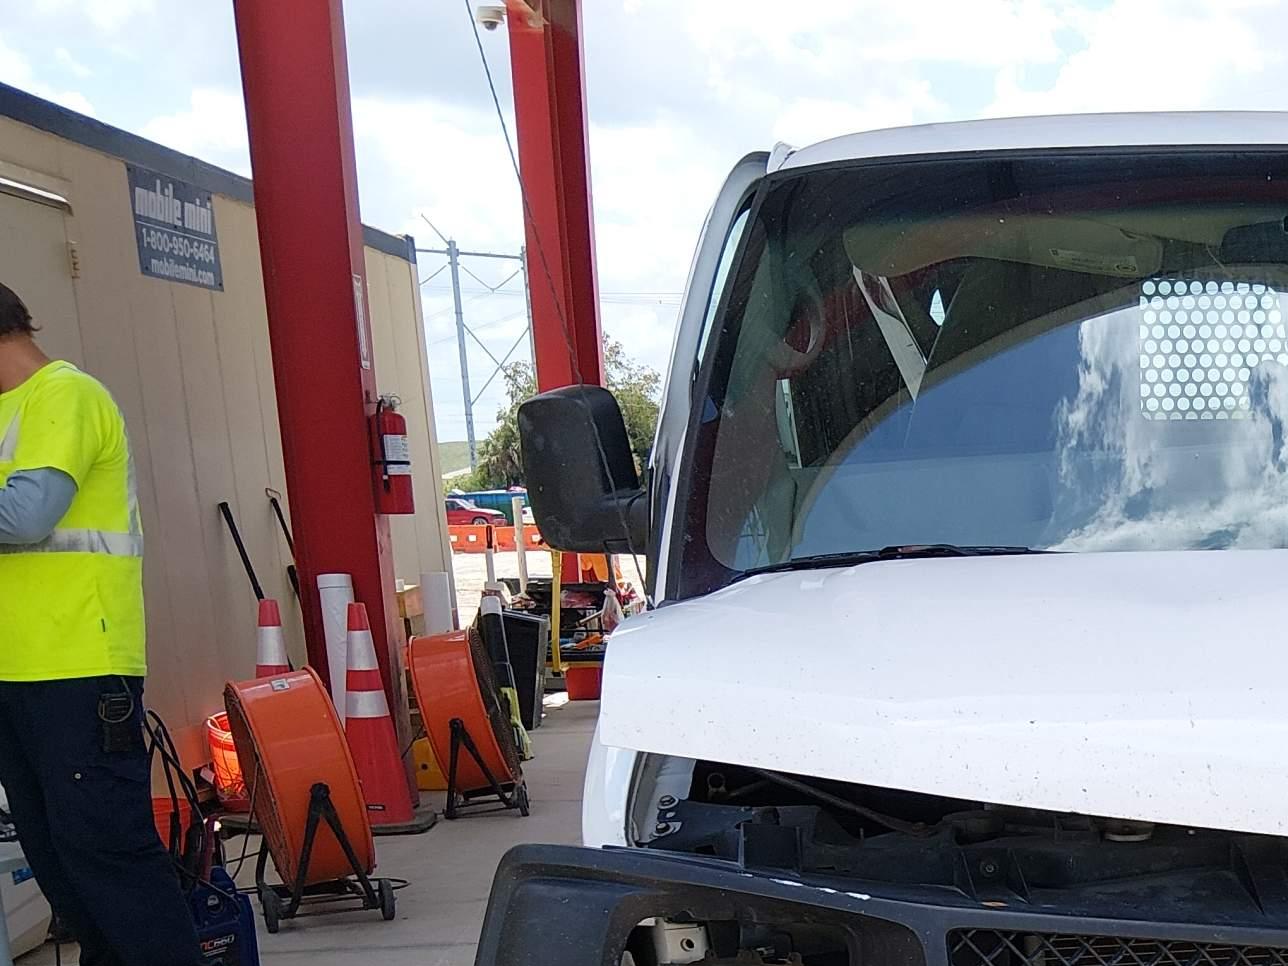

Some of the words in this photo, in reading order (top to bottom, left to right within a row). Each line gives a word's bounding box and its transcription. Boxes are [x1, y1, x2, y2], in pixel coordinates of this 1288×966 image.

[135, 179, 182, 226] mobile
[184, 198, 211, 235] mini
[142, 228, 215, 264] 1-800-950-6464
[151, 258, 215, 286] mobilemini.com
